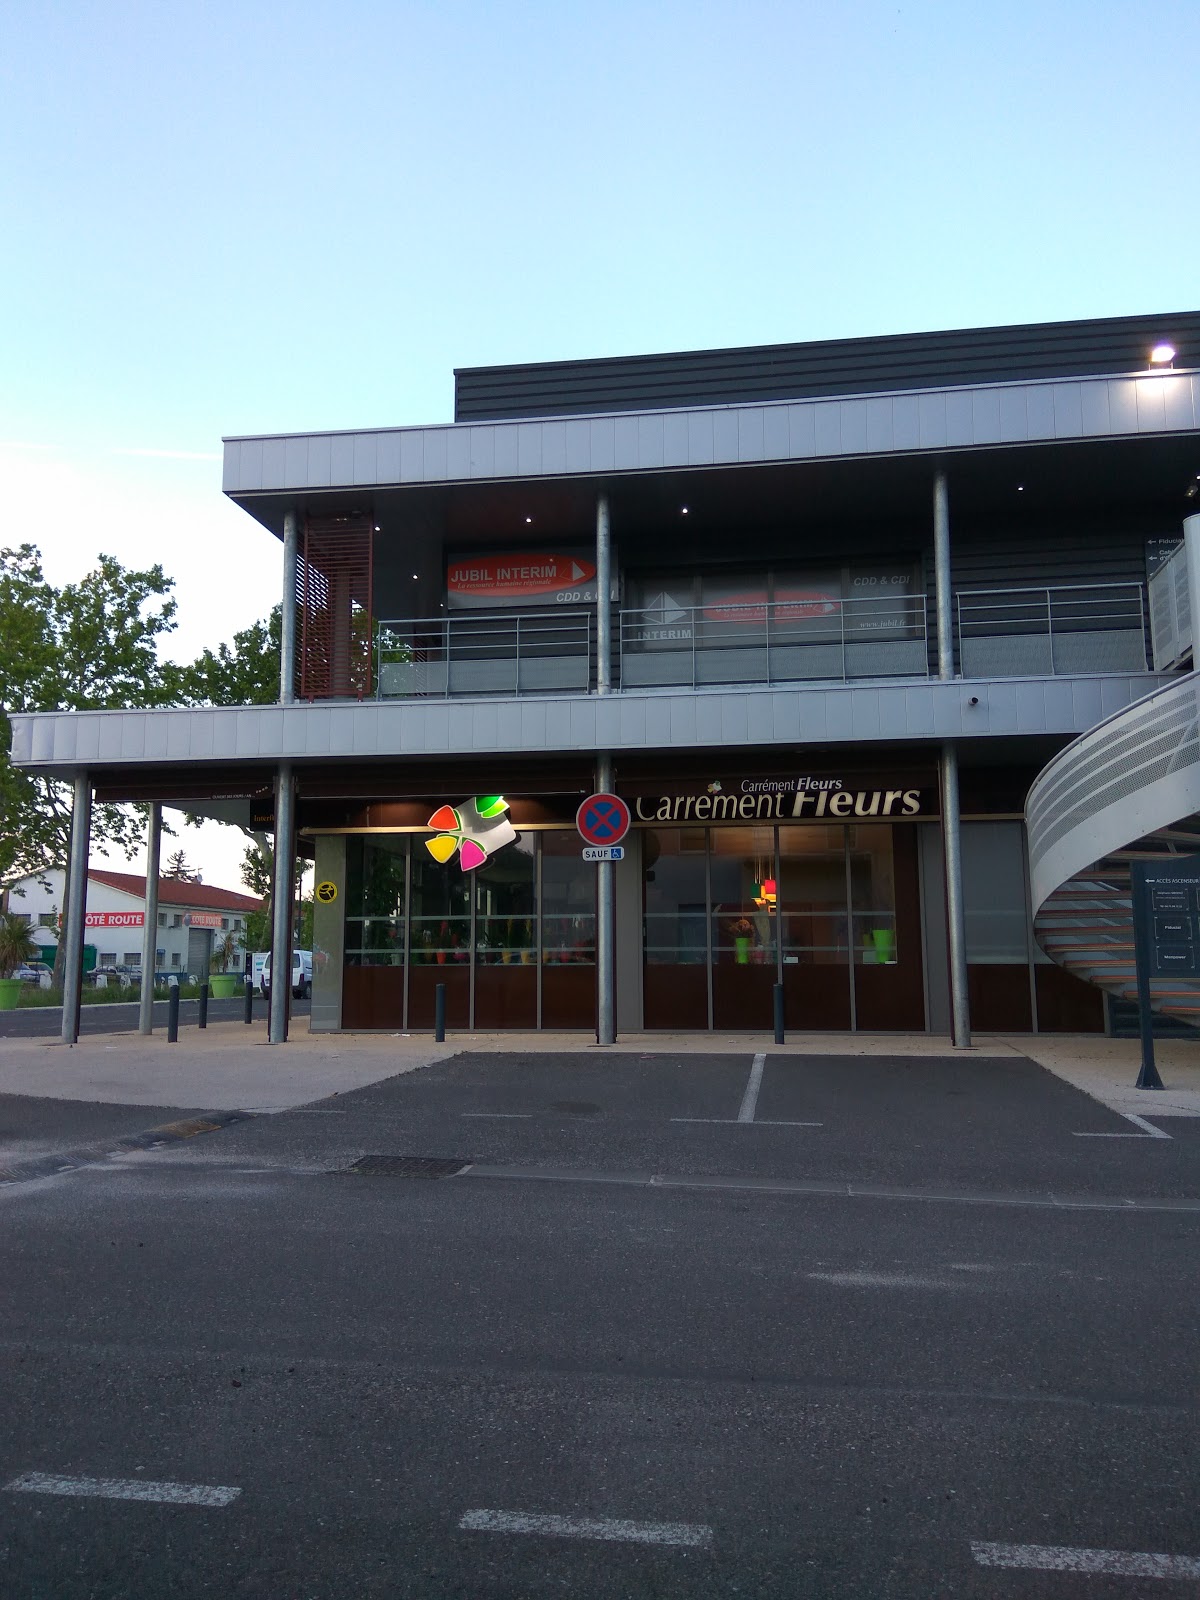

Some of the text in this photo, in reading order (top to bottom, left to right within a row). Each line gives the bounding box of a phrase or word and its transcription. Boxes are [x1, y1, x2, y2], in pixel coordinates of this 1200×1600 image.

[450, 565, 557, 582] JUBIL INTERIM
[853, 575, 911, 586] CDD & CDI
[556, 592, 580, 602] CDD
[583, 591, 592, 600] &
[637, 629, 692, 640] INTERIM
[740, 776, 843, 792] Carrément Fleurs
[585, 850, 609, 859] SAUF
[85, 913, 142, 925] ÔTÉ ROUTE
[205, 916, 222, 925] ROUTE
